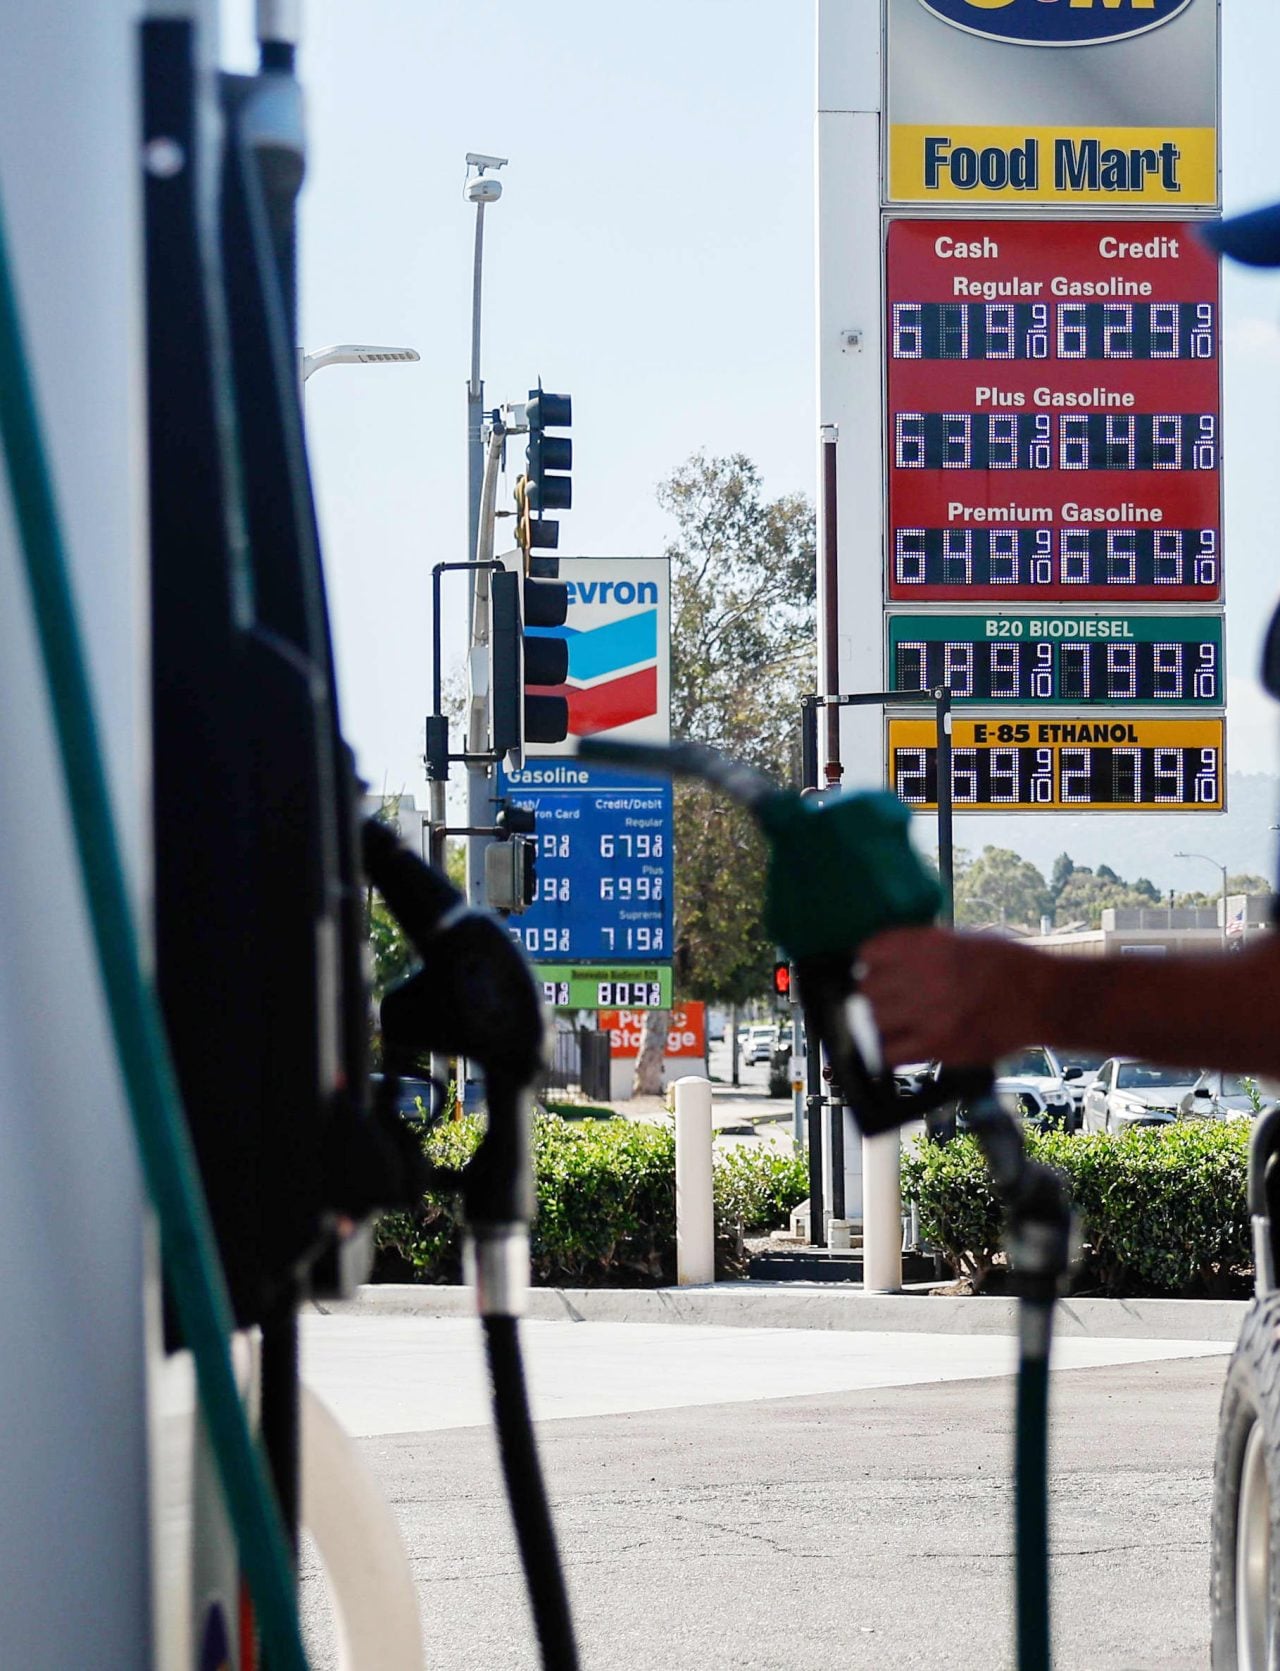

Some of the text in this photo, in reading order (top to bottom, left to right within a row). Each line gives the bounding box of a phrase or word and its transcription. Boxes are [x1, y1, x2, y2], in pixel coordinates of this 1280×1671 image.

[924, 137, 1180, 191] Food Mart
[934, 236, 998, 259] Cash
[1099, 237, 1179, 259] Credit
[953, 277, 1152, 300] Regular Gasoline
[975, 387, 1135, 407] Plus Gasoline
[948, 502, 1163, 523] Premium Gasoline
[565, 581, 658, 605] evron
[985, 620, 1134, 638] B20 BIODIESEL
[974, 724, 1138, 743] E-85 ETHANOL
[508, 767, 589, 784] Gasoline
[555, 809, 580, 819] Card
[595, 799, 662, 810] Credit/Debit
[625, 818, 663, 828] Regular
[642, 865, 664, 875] Plus
[619, 910, 662, 920] Supreme
[610, 1029, 696, 1052] Stoge
